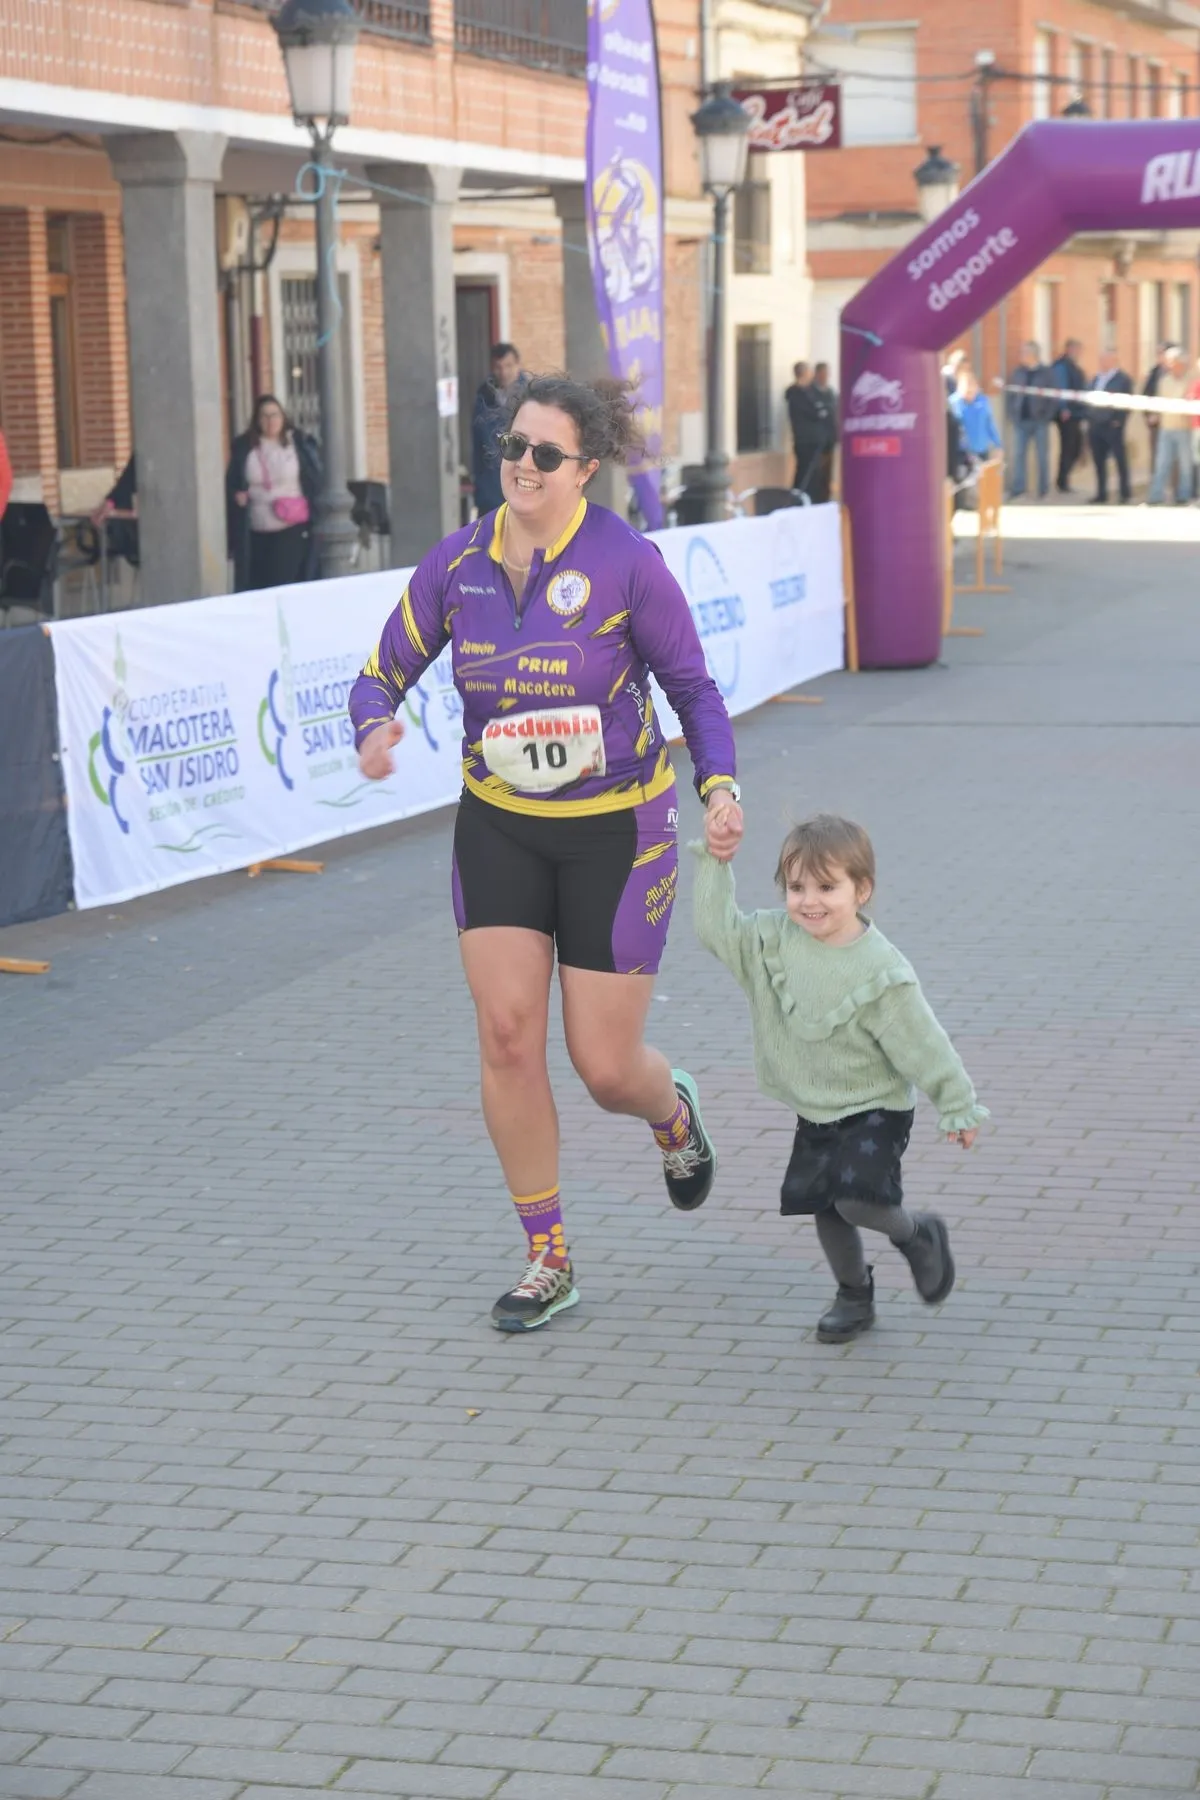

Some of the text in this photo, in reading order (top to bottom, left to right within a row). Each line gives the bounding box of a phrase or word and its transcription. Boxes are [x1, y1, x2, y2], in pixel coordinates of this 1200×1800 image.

[907, 207, 980, 280] somos
[928, 227, 1018, 311] deporte
[518, 656, 568, 675] PRIM
[296, 679, 356, 718] MACOT
[504, 678, 575, 697] Macotera
[178, 747, 239, 788] ISIDRO
[523, 742, 567, 770] 10
